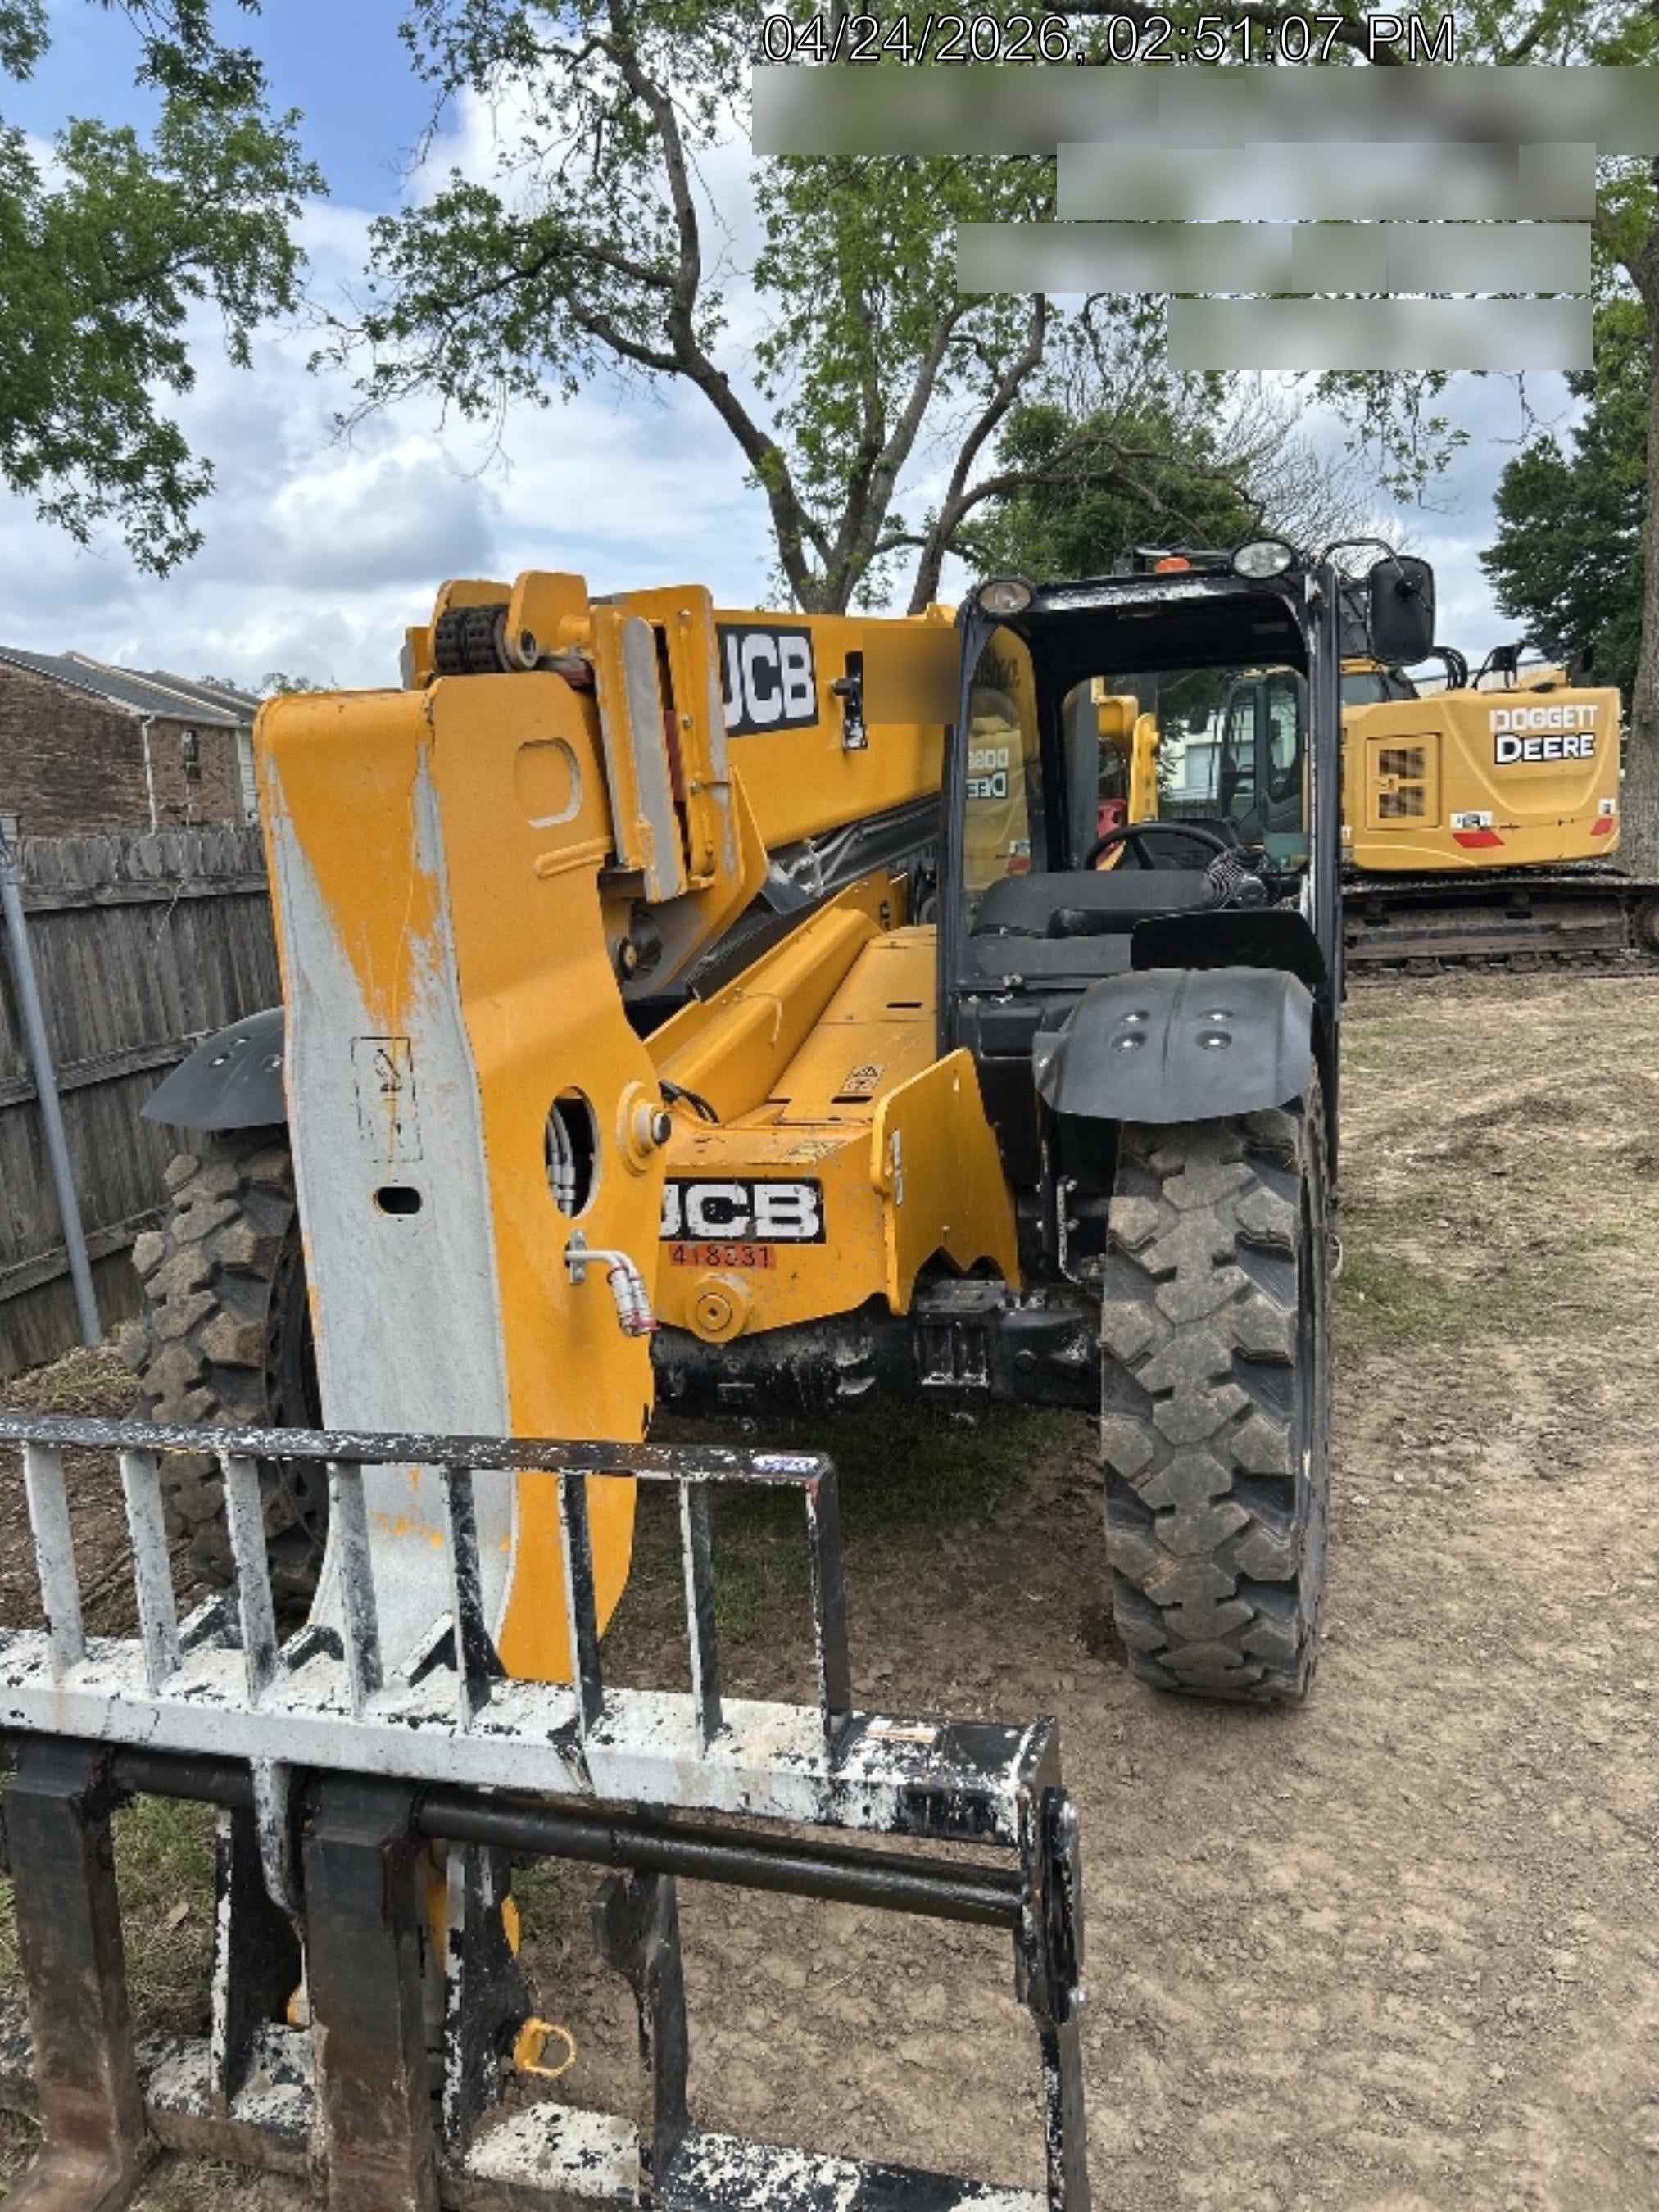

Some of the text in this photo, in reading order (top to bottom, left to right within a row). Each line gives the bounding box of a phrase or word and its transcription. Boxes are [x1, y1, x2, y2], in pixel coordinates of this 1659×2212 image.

[723, 633, 815, 728] JCB
[1489, 705, 1598, 733] DOGGETT
[1497, 735, 1595, 764] DEERE
[658, 1183, 820, 1239] JCB
